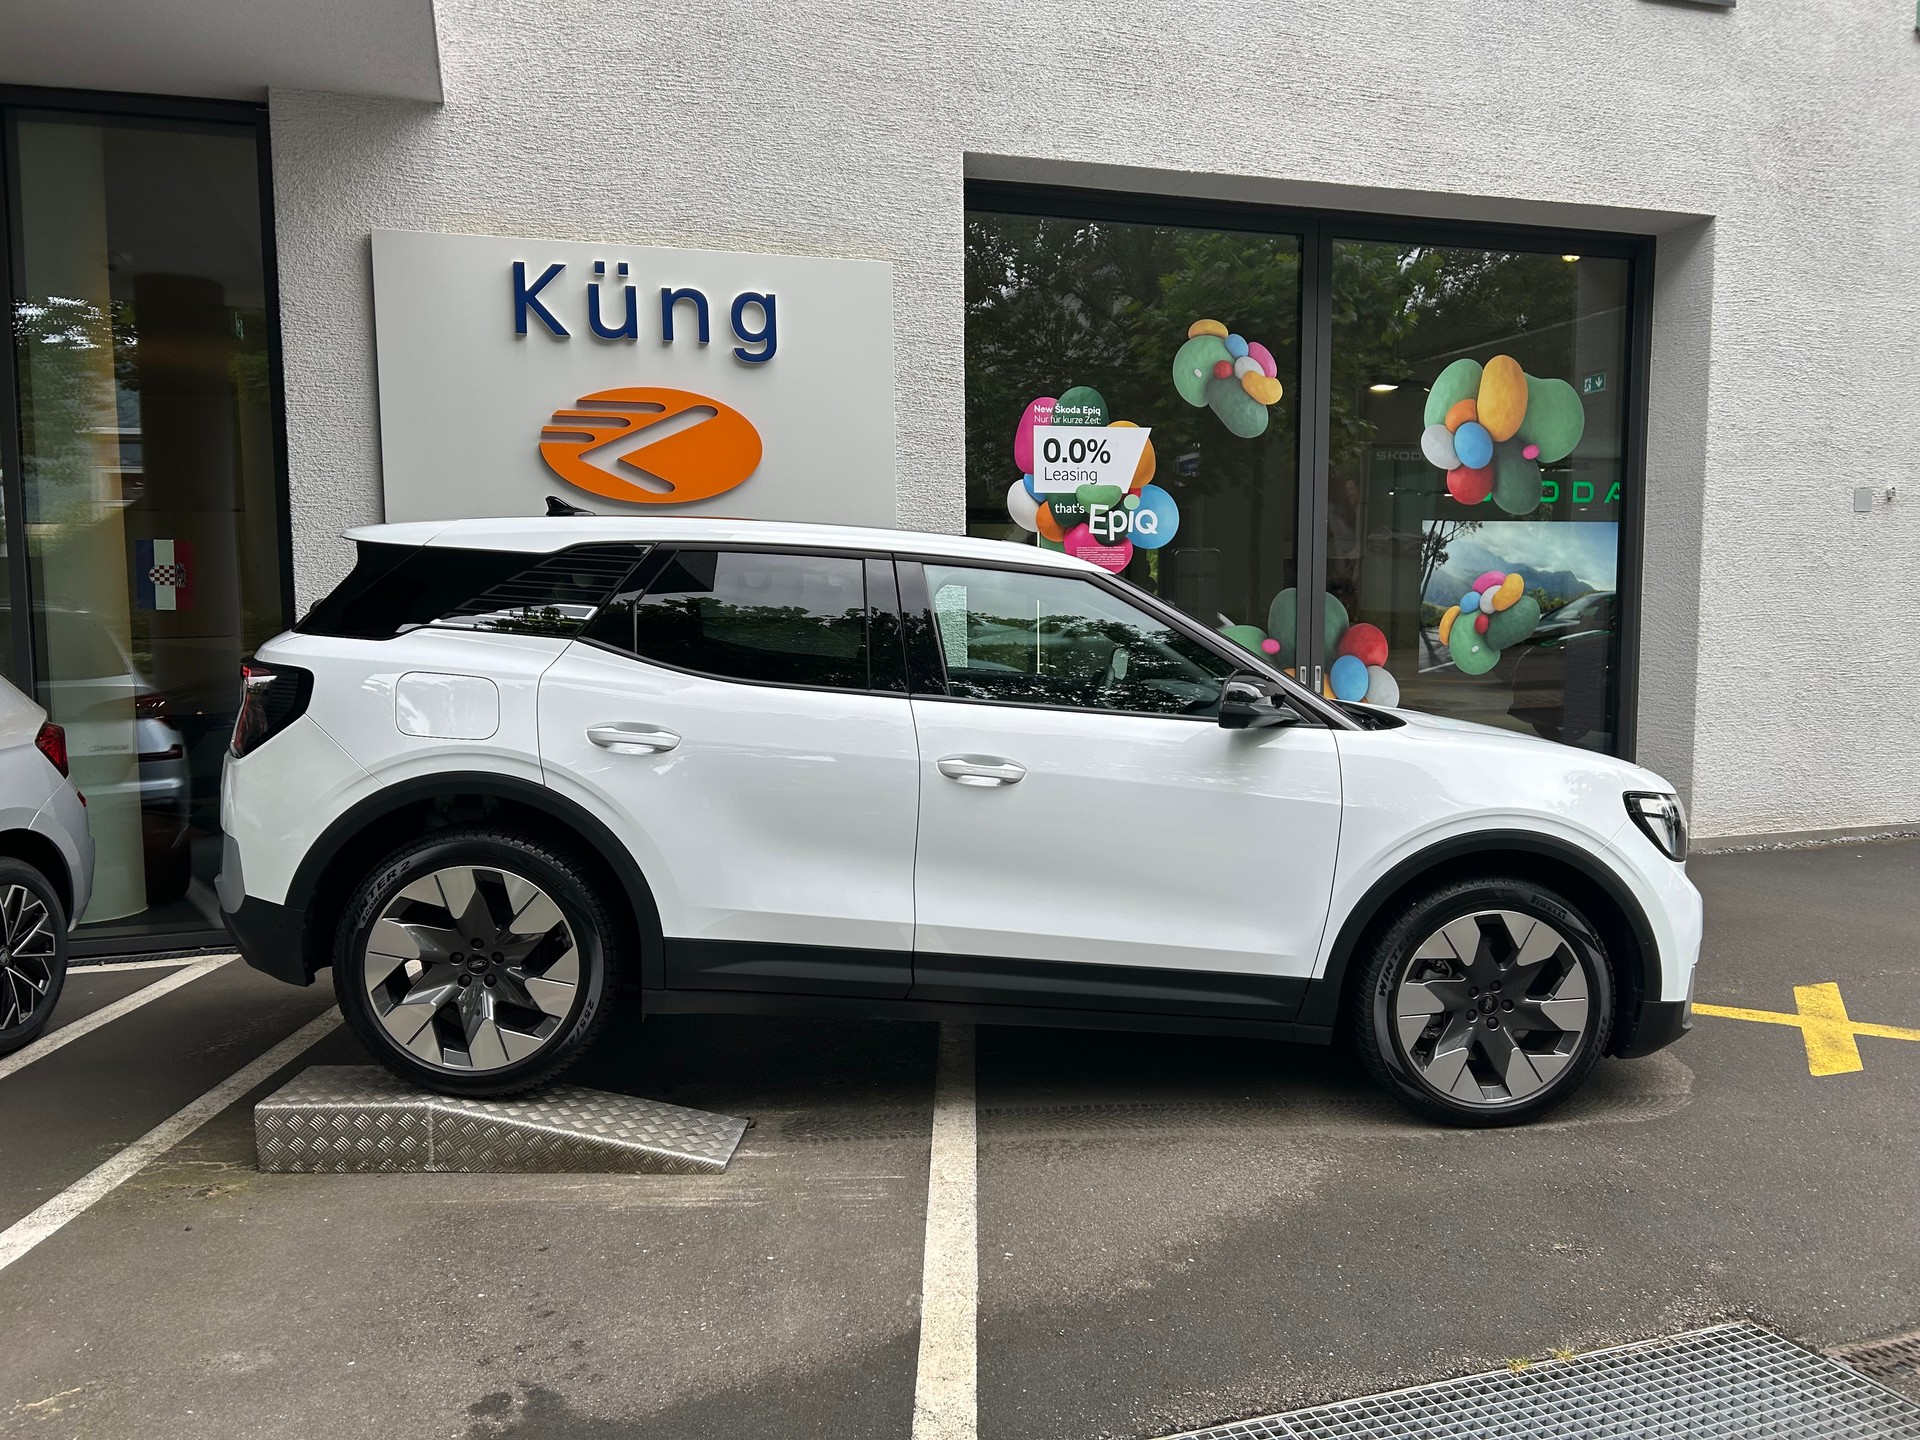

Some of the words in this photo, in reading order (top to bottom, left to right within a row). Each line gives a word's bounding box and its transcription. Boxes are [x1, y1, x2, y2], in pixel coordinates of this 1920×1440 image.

[512, 260, 778, 363] Küng
[1034, 404, 1053, 413] New
[1055, 403, 1081, 414] Škoda
[1083, 405, 1101, 416] Epiq
[1034, 415, 1049, 423] Nur
[1050, 415, 1061, 424] für
[1062, 416, 1083, 424] kurze
[1084, 416, 1102, 425] Zeit:
[1043, 437, 1111, 464] 0.0%
[1044, 467, 1098, 484] Leasing
[400, 860, 410, 873] 2
